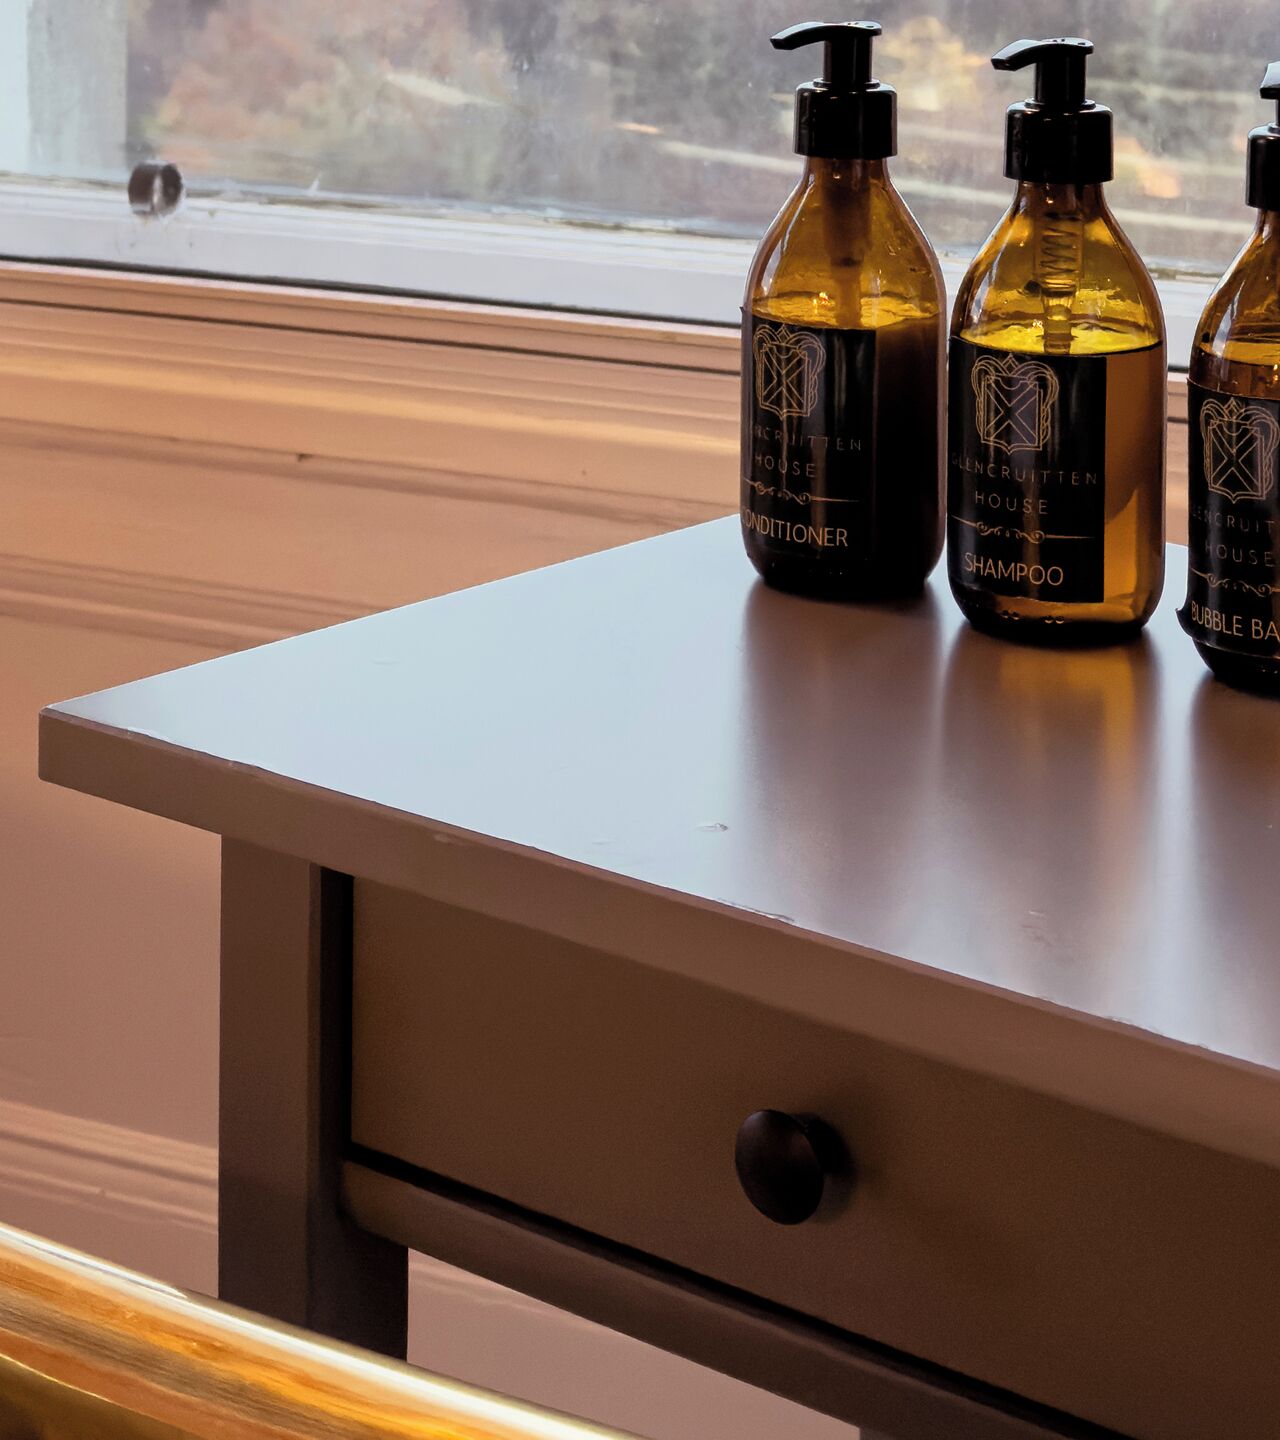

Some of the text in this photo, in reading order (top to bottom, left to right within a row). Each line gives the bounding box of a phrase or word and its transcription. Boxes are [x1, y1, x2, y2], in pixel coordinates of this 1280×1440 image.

[754, 451, 817, 479] HOUSE
[975, 490, 1050, 516] HOUSE
[742, 507, 849, 548] ONDITIONER
[964, 552, 1065, 587] SHAMPOO
[1204, 539, 1276, 568] HOUSE
[1191, 598, 1245, 638] BUBBLE
